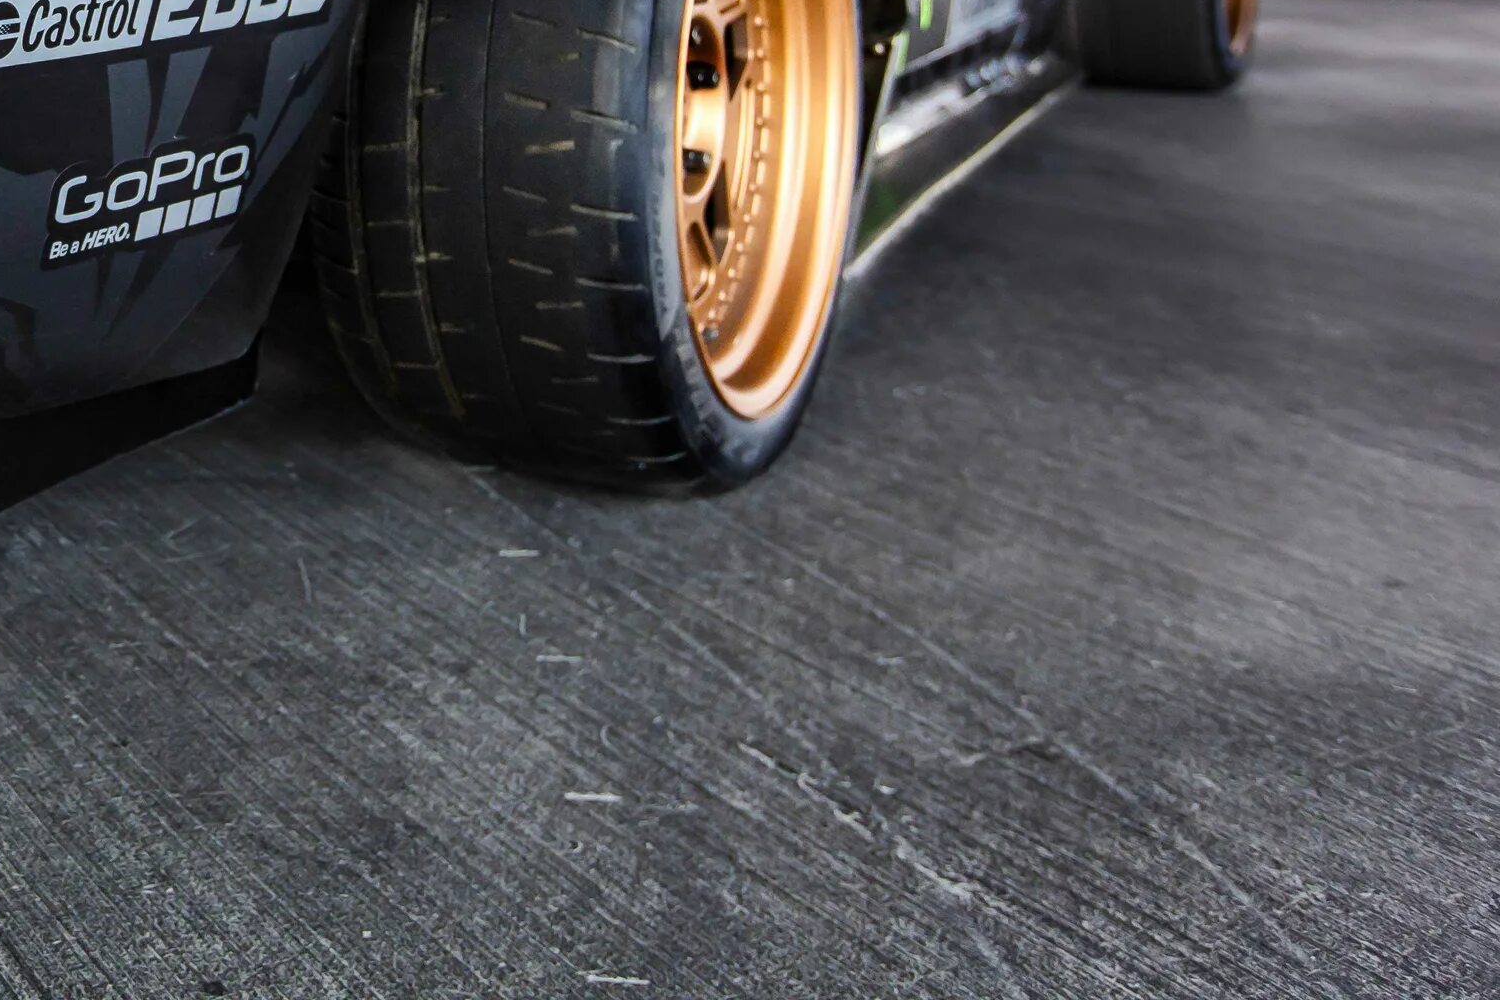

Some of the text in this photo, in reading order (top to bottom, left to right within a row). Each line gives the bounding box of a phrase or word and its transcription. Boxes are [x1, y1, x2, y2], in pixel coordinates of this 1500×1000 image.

[54, 145, 250, 224] GoPro
[49, 222, 131, 260] Be a HERO.
